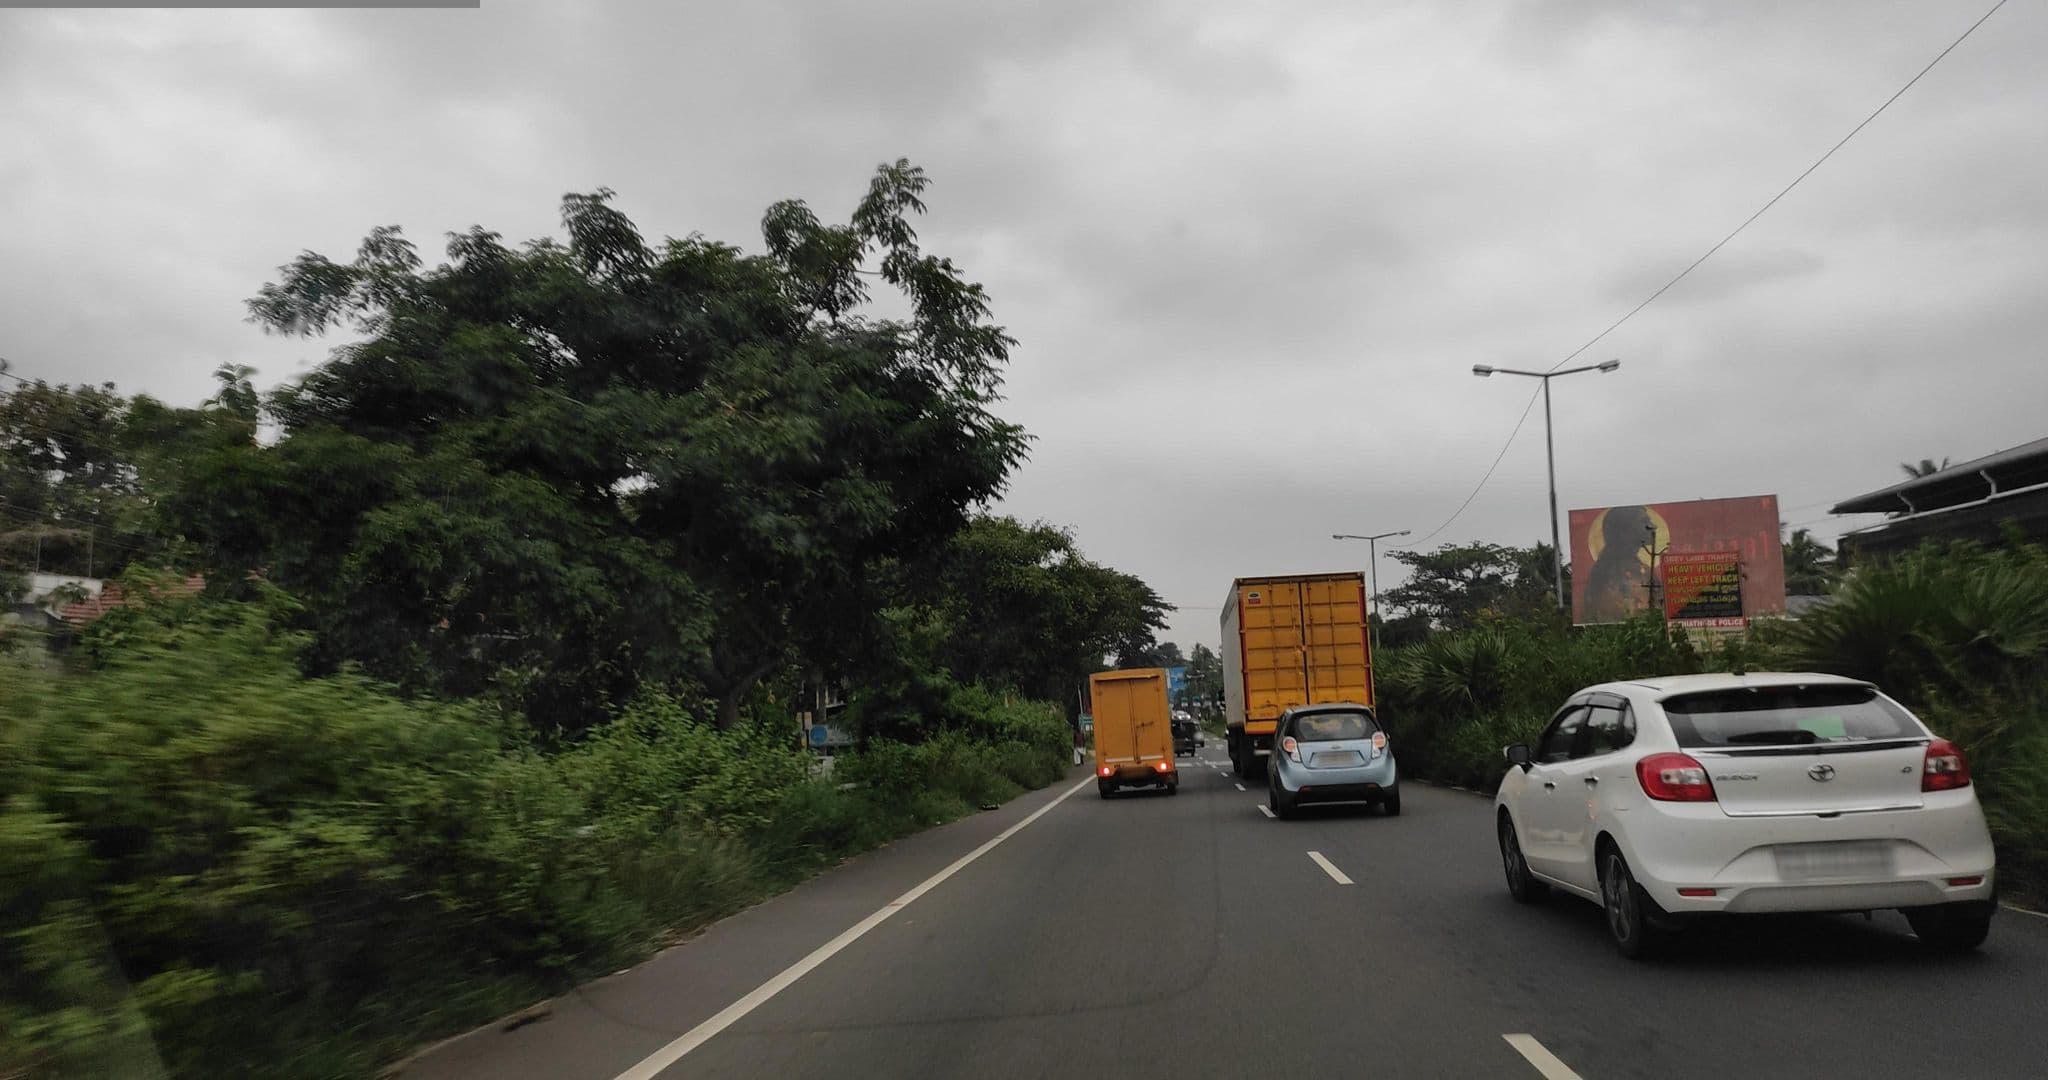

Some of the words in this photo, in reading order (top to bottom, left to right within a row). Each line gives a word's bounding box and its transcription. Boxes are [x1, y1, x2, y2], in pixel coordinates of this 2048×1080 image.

[1708, 553, 1738, 562] TRAFFIC
[1668, 564, 1693, 574] HEAVY
[1696, 563, 1735, 573] VEHICLES
[1667, 575, 1688, 585] KEEP
[1690, 575, 1710, 584] LEFT
[1712, 574, 1739, 584] TRACK
[1718, 618, 1744, 627] POLICE
